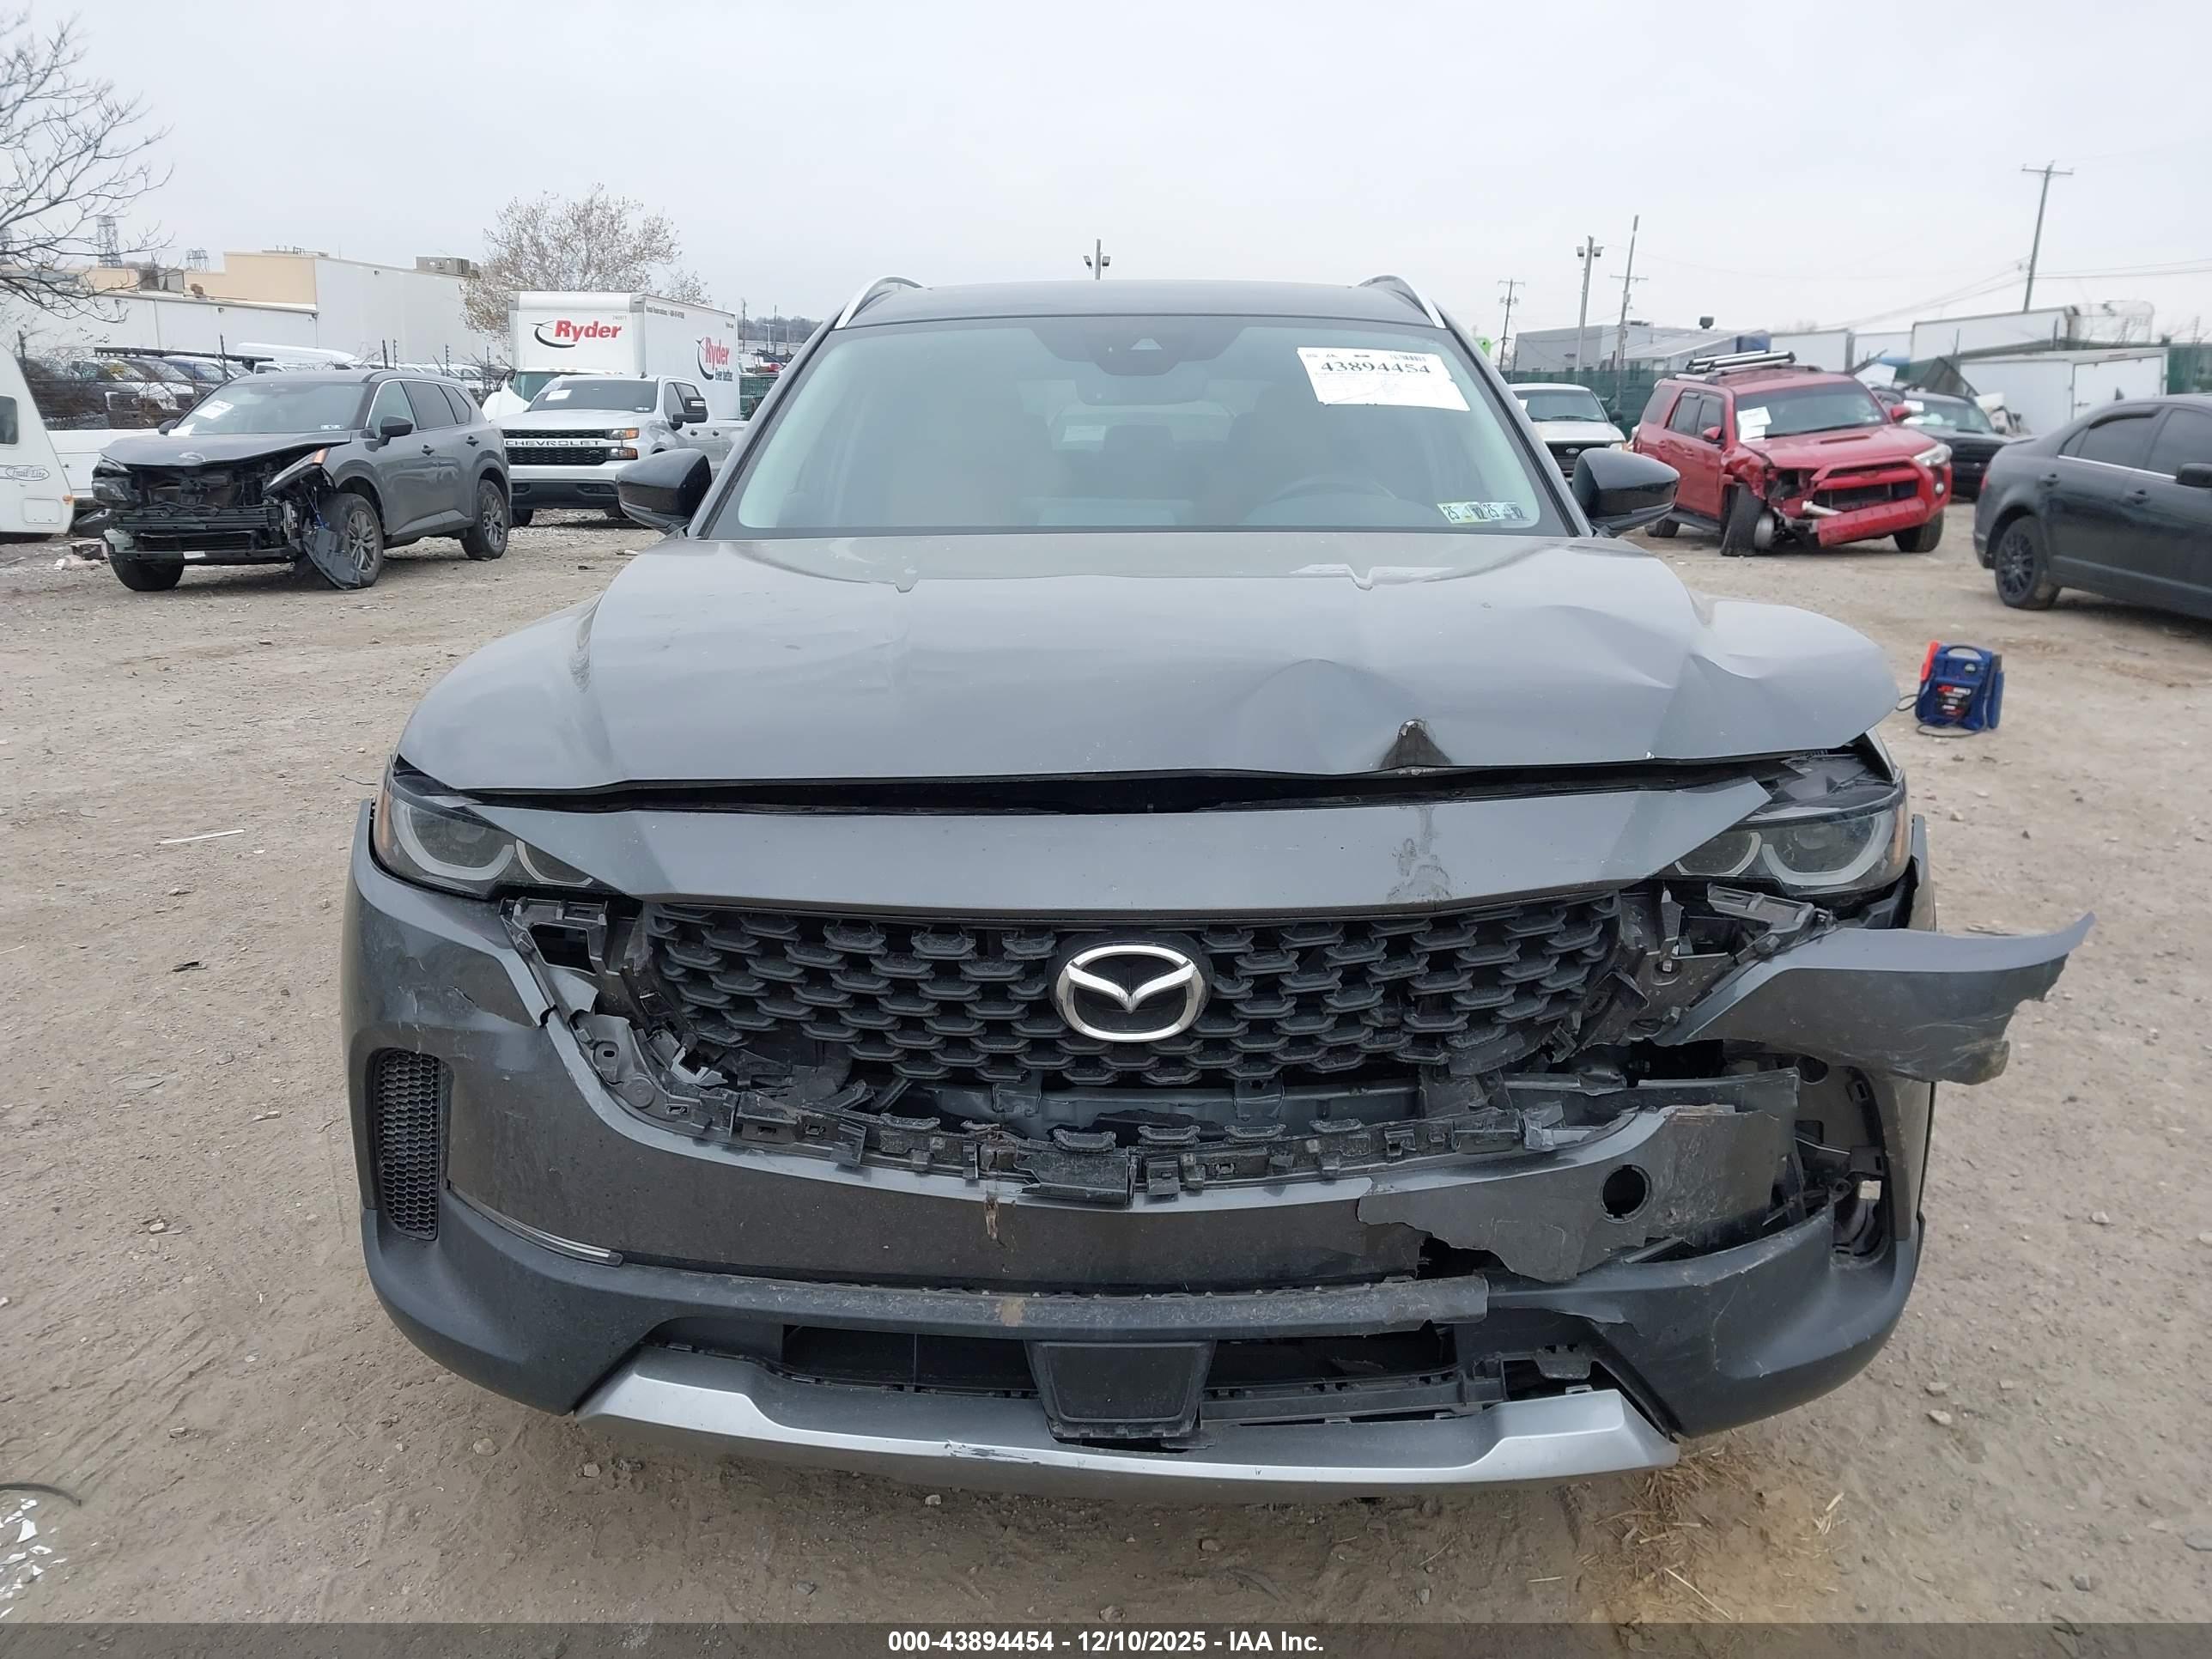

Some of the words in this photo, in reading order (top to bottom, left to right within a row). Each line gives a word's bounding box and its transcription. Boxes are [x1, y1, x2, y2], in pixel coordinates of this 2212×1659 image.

[555, 319, 622, 342] Ryder
[705, 337, 729, 369] Ryder
[1322, 362, 1431, 374] 43894454
[1443, 506, 1460, 520] 25
[1482, 504, 1499, 518] 25
